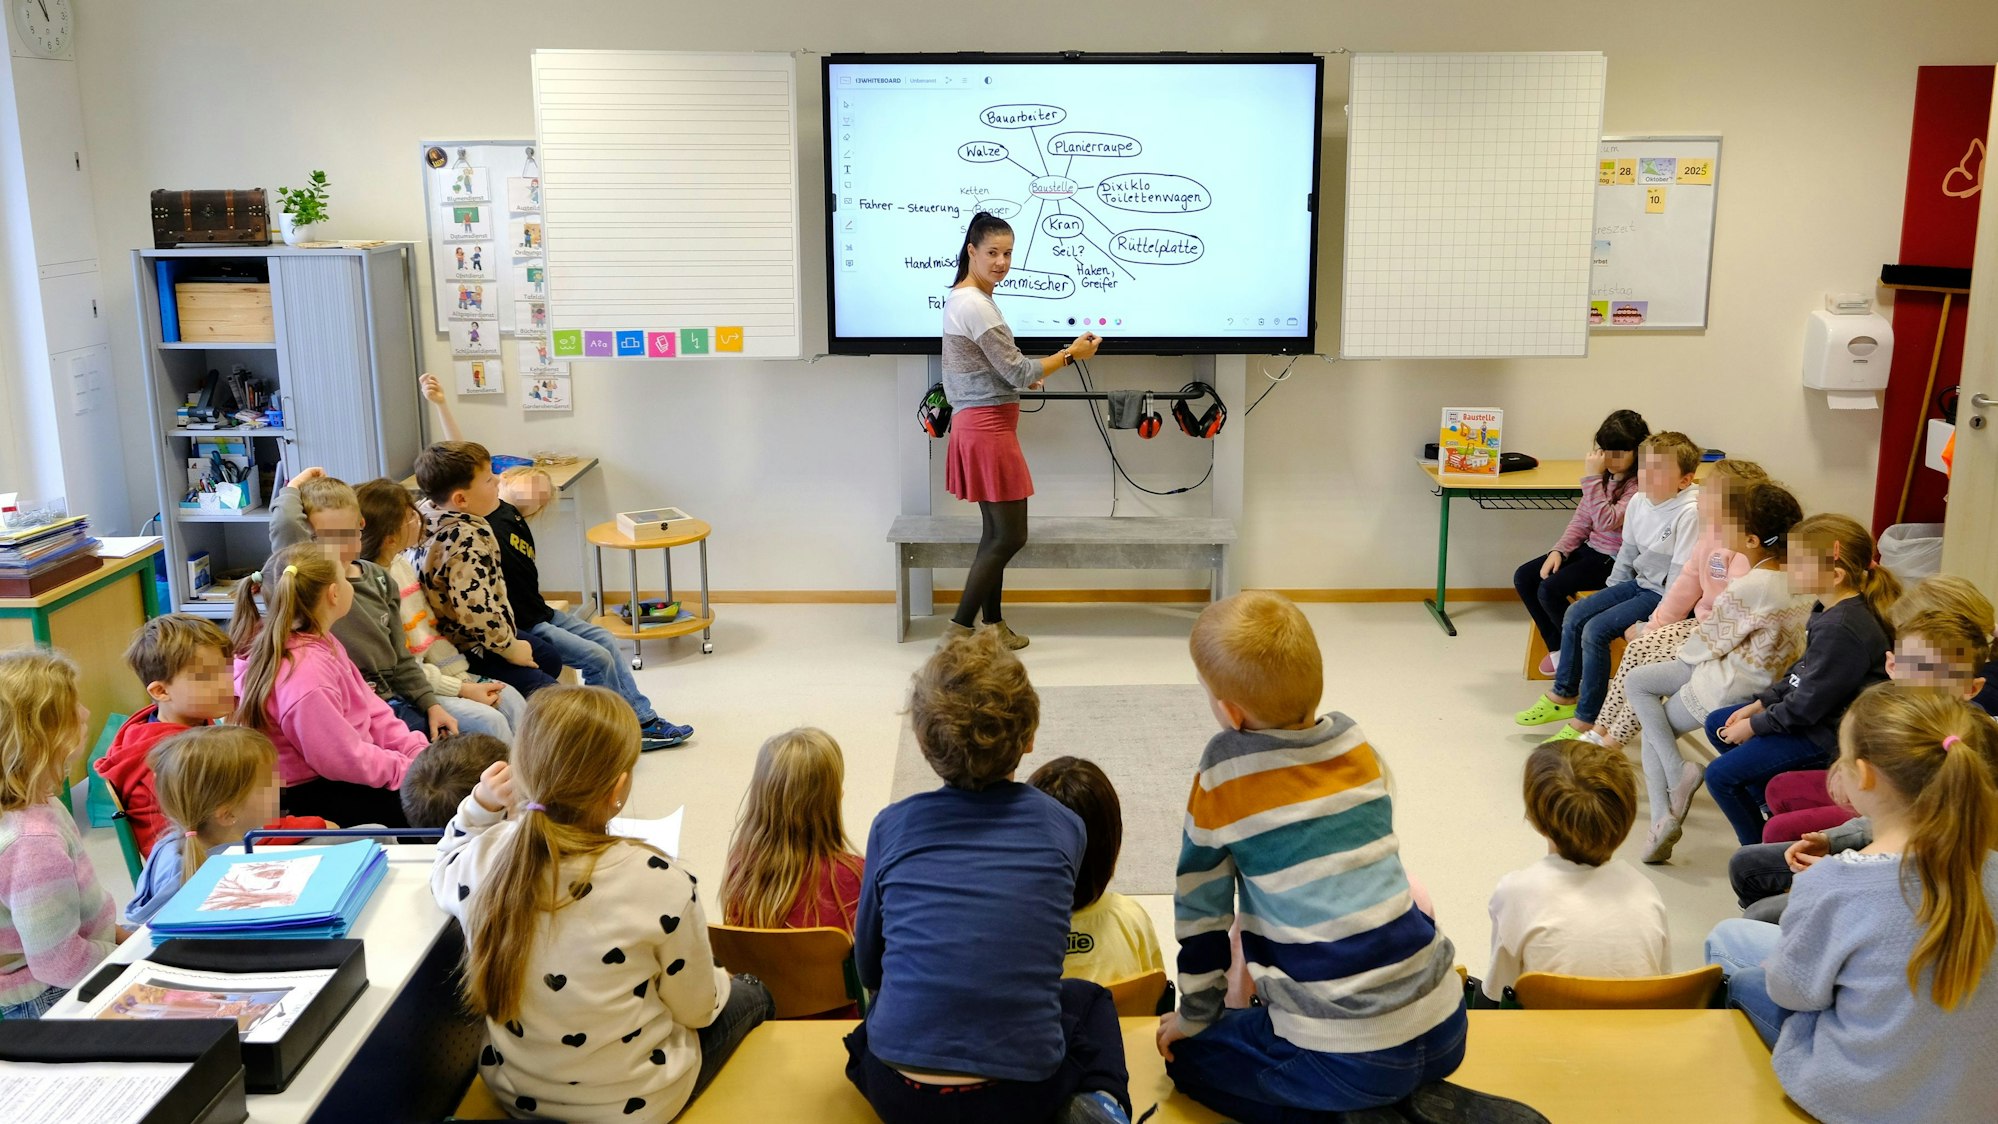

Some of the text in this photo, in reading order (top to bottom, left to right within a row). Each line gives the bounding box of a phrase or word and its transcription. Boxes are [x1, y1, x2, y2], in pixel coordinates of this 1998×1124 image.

[987, 110, 1057, 124] Bauarbeiter
[966, 146, 1001, 157] Walze
[1055, 140, 1133, 157] Planierraupe
[1684, 166, 1707, 176] 2025
[1031, 182, 1074, 192] Baustelle
[1102, 179, 1150, 192] Dixiklo
[1102, 193, 1202, 210] Toilettenwagen
[1649, 195, 1661, 204] 10.
[859, 199, 960, 218] Fahrer Steuerung
[1049, 218, 1080, 230] Kran
[1118, 236, 1198, 258] Rüttelplatte
[1077, 264, 1115, 277] Haken,
[1081, 278, 1118, 292] Greifer
[1463, 413, 1496, 422] Baustelle
